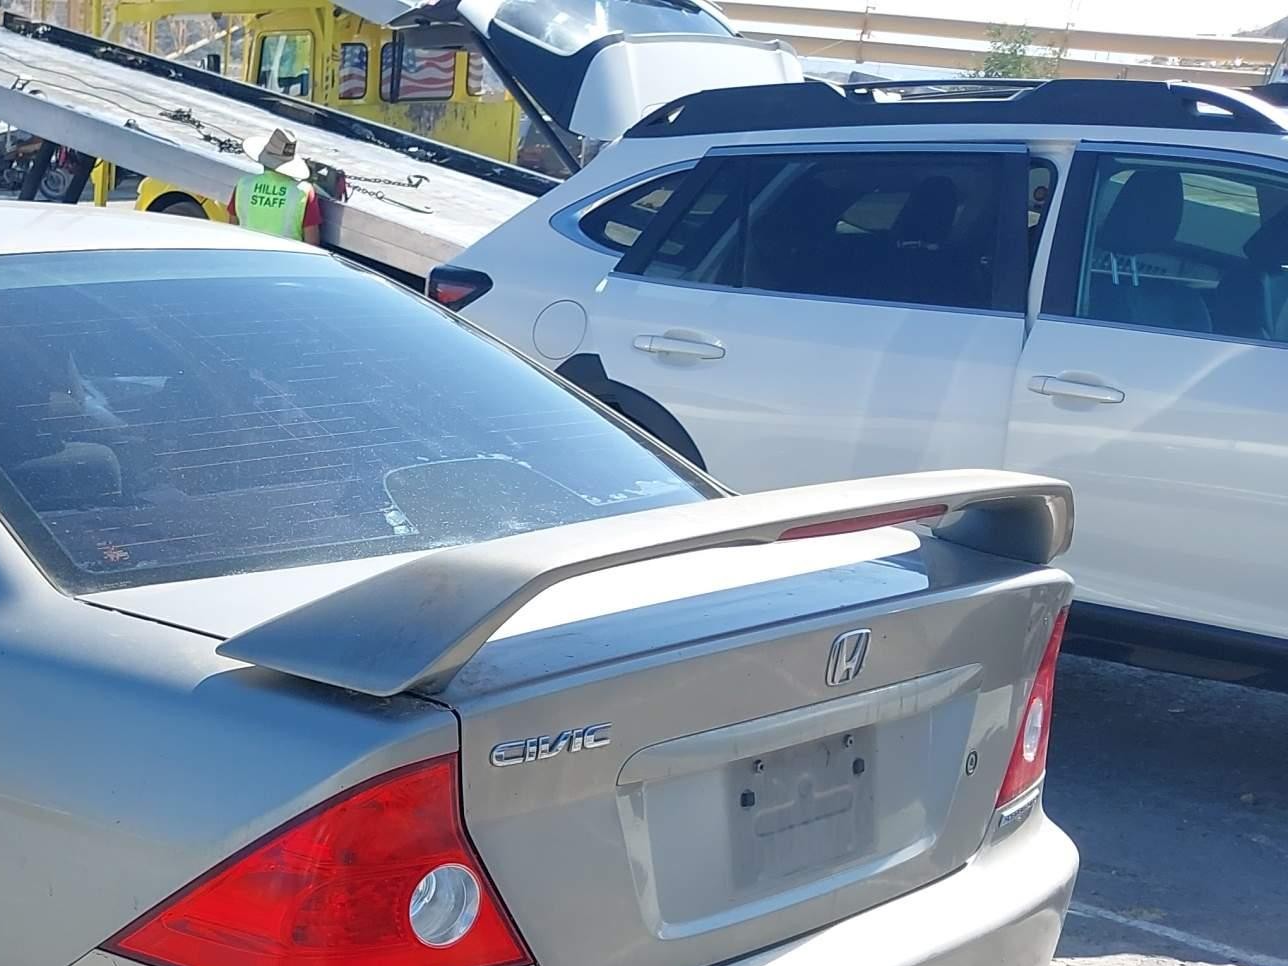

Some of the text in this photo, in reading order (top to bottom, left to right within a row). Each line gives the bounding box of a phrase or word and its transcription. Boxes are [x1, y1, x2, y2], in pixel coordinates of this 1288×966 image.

[253, 183, 287, 197] HILLS
[250, 195, 286, 208] STAFF
[489, 721, 613, 767] CIVIC
